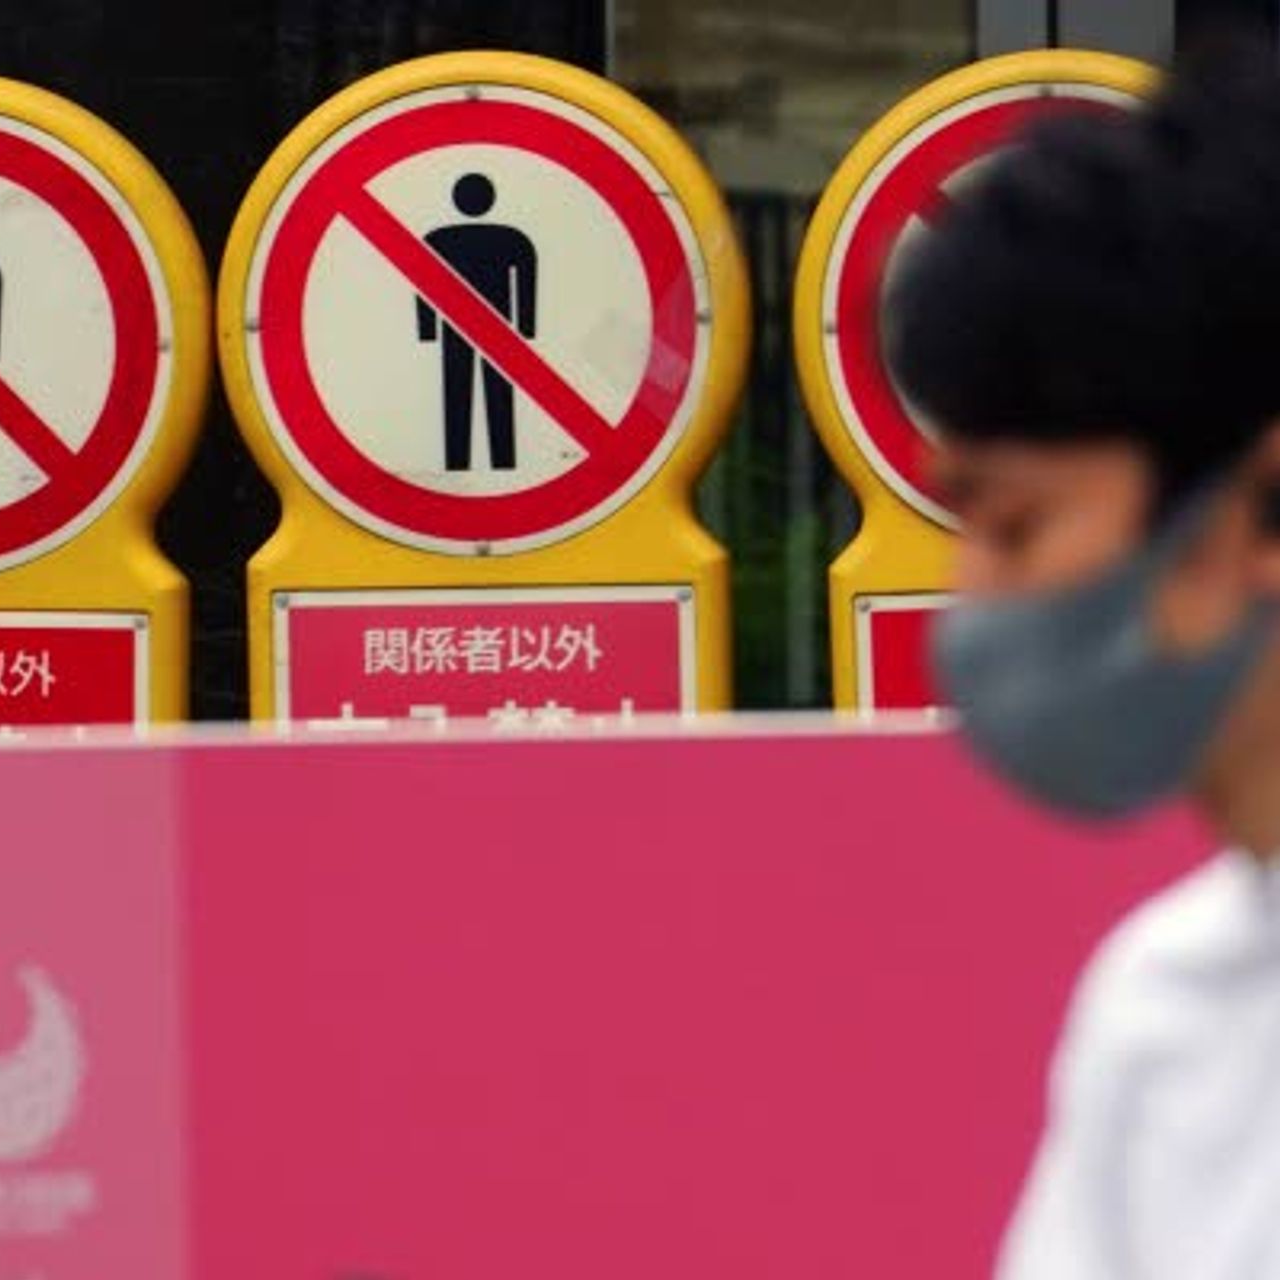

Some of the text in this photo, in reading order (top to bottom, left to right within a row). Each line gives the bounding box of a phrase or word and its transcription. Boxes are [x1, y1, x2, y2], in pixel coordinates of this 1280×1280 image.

[363, 622, 602, 675] 関係者以外
